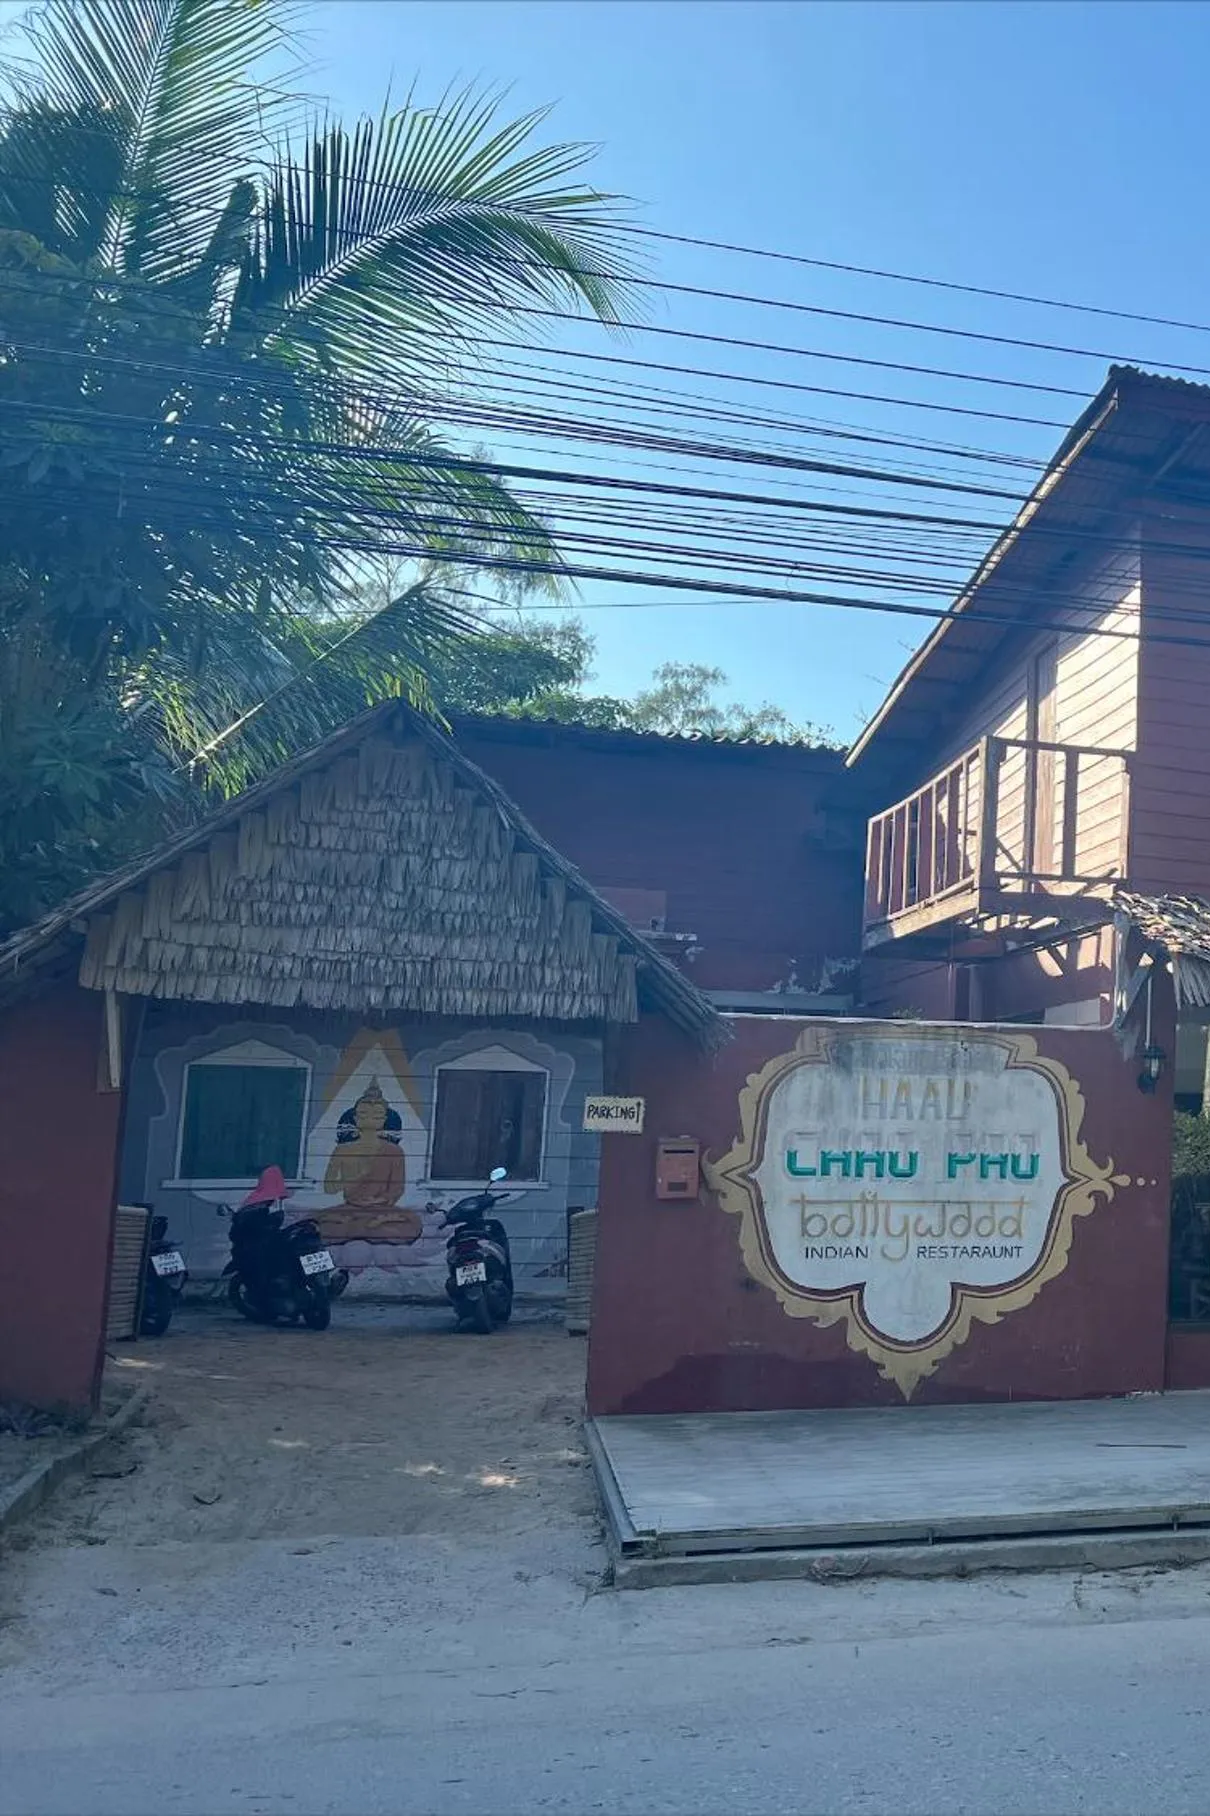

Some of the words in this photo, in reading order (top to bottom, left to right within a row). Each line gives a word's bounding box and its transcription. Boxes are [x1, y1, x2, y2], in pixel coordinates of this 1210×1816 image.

[587, 1104, 635, 1119] PARKING
[805, 1246, 868, 1259] INDIAN
[917, 1245, 1023, 1259] RESTARAUNT
